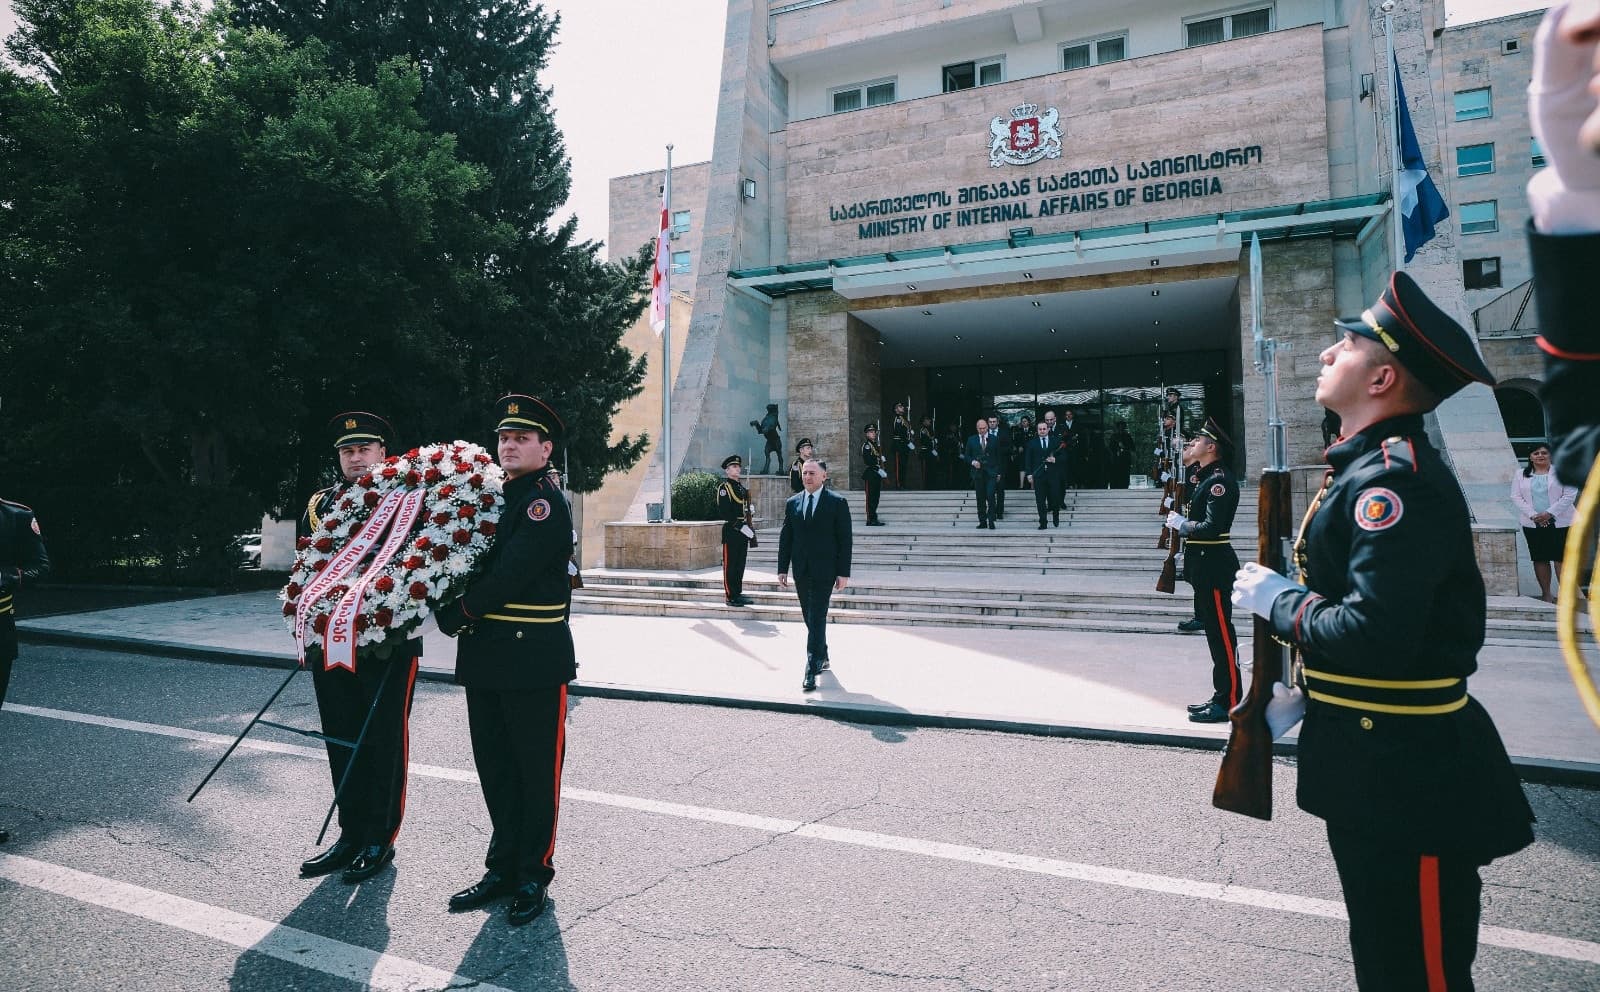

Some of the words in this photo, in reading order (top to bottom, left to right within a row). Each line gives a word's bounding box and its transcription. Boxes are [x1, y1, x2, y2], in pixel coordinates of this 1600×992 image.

[830, 190, 951, 222] საქართველოს
[958, 178, 1030, 204] შინაგან
[1037, 166, 1119, 193] საქმეთა
[1127, 145, 1262, 180] სამინისტრო
[858, 215, 928, 239] MINISTRY
[933, 212, 951, 230] OF
[957, 201, 1033, 227] INTERNAL
[1038, 191, 1109, 217] AFFAIRS
[1114, 188, 1137, 207] OF
[1143, 177, 1223, 203] GEORGIA
